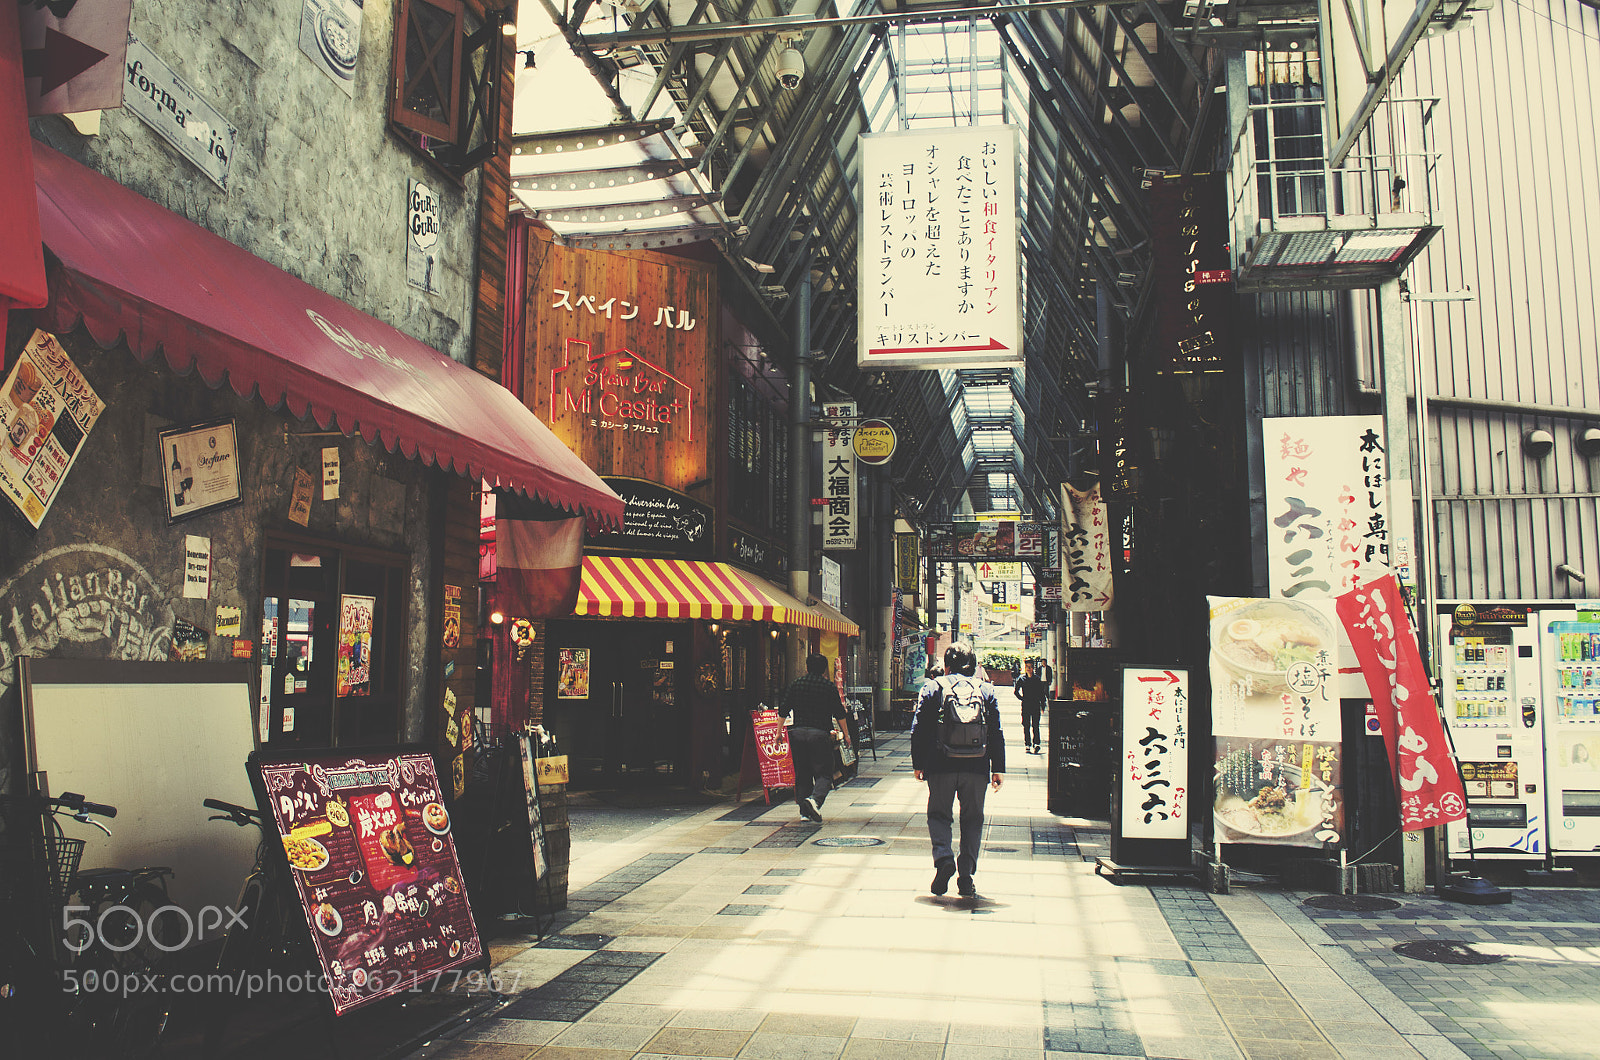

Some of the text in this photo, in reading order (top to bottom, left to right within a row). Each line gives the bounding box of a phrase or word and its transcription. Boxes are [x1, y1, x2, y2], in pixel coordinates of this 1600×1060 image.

[413, 190, 437, 216] GURU
[413, 214, 438, 236] GURU
[901, 163, 917, 259] ヨーロッパの
[925, 145, 941, 276] オシャレを超えた
[981, 141, 998, 314] おいしい和食イタリアン
[879, 173, 894, 317] 芸術レストランバー
[956, 155, 974, 314] 食べたことありますか
[552, 288, 696, 331] スペイン バル
[876, 331, 981, 346] キリストンバー
[37, 334, 91, 404] チンチロリン
[584, 362, 667, 394] Spain Bar
[54, 376, 89, 429] ハイボール
[565, 386, 592, 414] Mi
[600, 420, 629, 430] カシータ
[632, 424, 660, 434] プリュス
[666, 498, 681, 510] bar
[828, 455, 851, 537] 大福商会
[1065, 522, 1093, 603] 六三六
[1316, 650, 1333, 702] 煮干し
[1147, 688, 1165, 720] 麺や
[1139, 727, 1170, 825] 六三六
